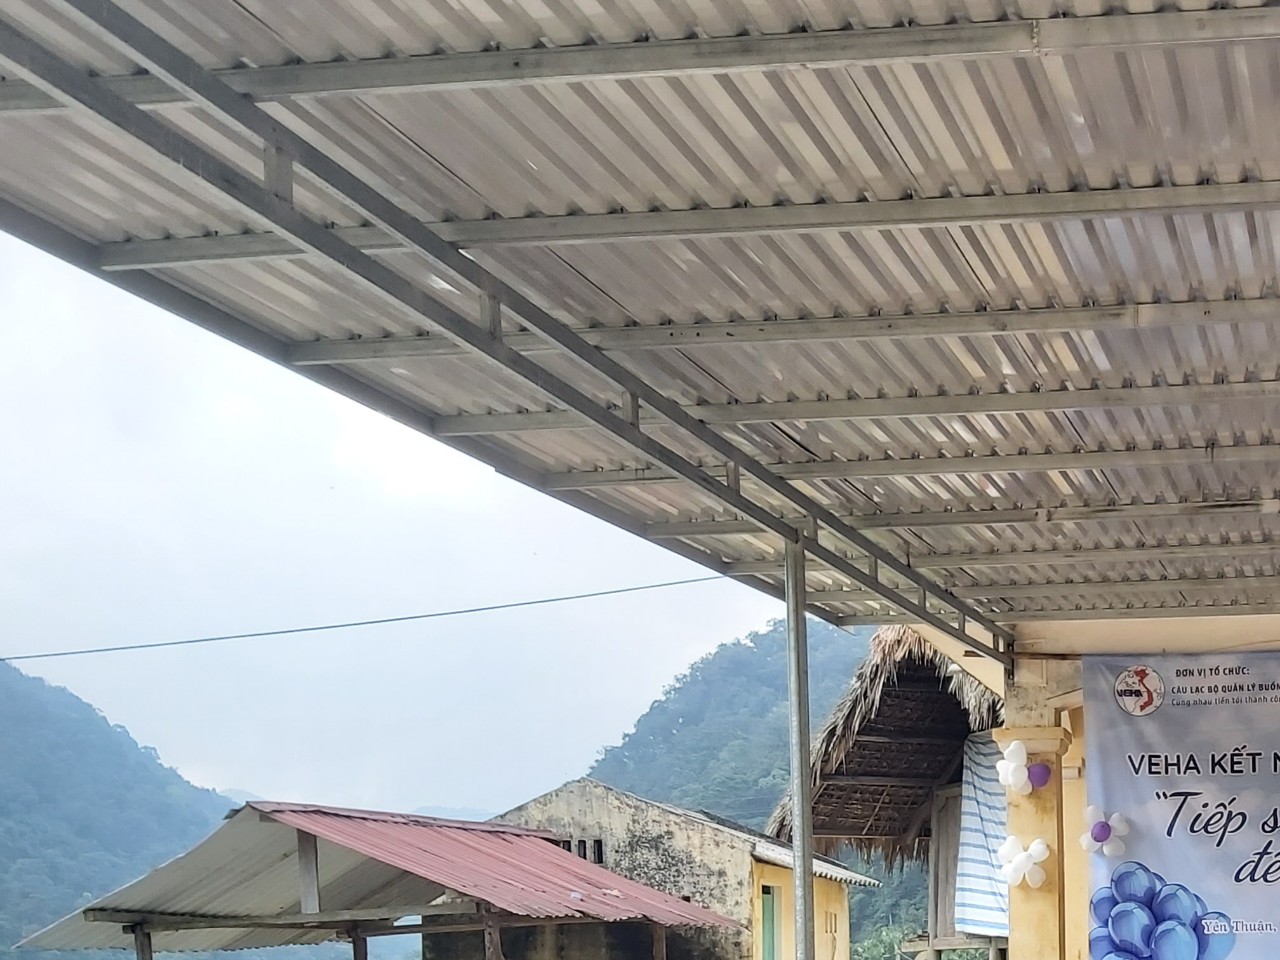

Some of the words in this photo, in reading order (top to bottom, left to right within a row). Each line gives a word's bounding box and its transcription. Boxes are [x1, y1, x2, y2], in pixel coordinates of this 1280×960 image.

[1128, 754, 1201, 775] VEHA
[1211, 744, 1262, 774] KẾT
[1203, 920, 1228, 932] Yên
[1232, 920, 1277, 934] Thuận,
